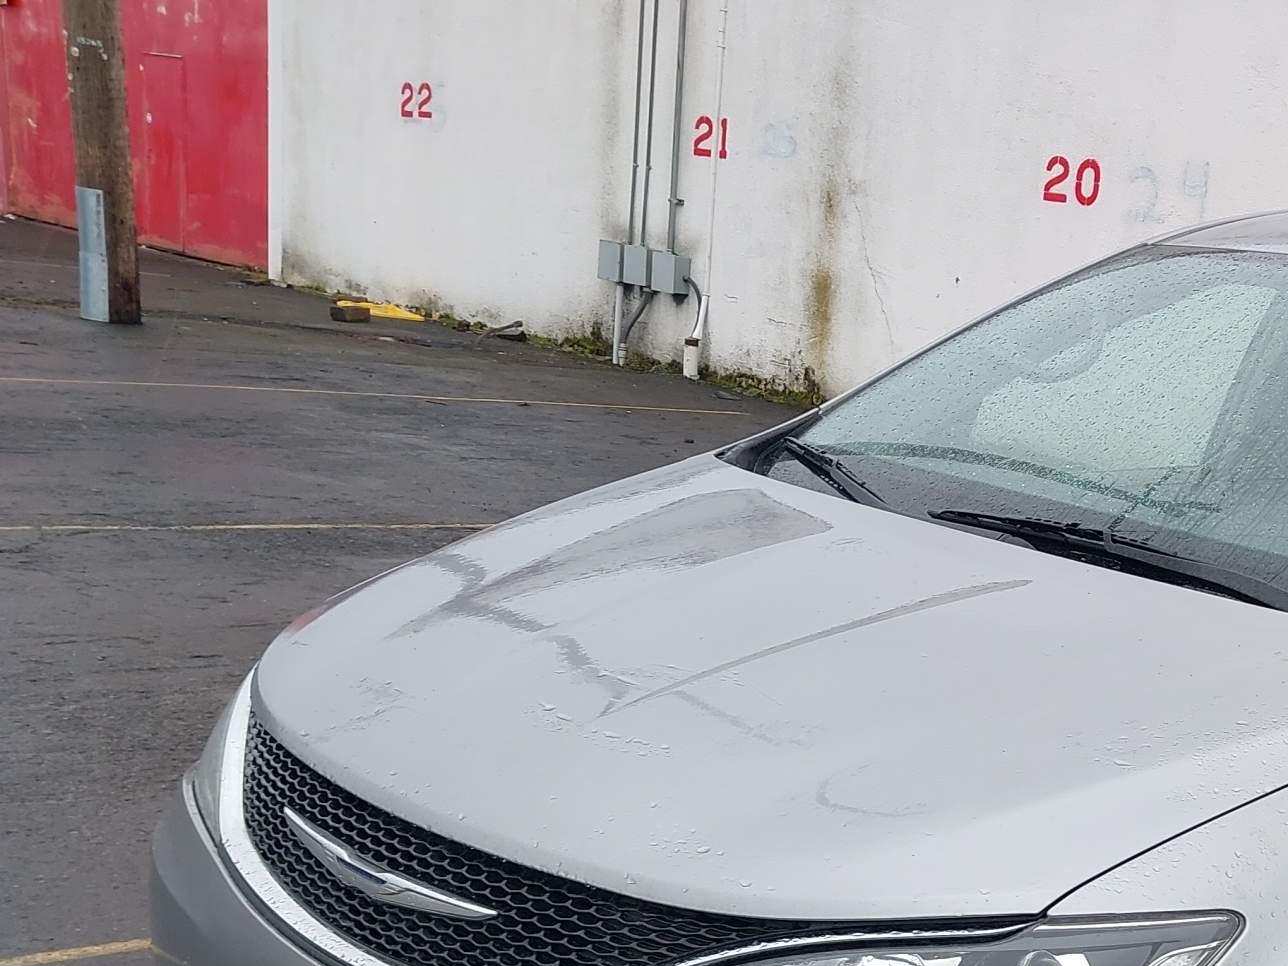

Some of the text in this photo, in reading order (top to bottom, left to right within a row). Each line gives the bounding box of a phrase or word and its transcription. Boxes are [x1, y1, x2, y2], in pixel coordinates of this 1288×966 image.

[400, 82, 433, 119] 22
[693, 115, 728, 159] 21
[1042, 155, 1102, 207] 20
